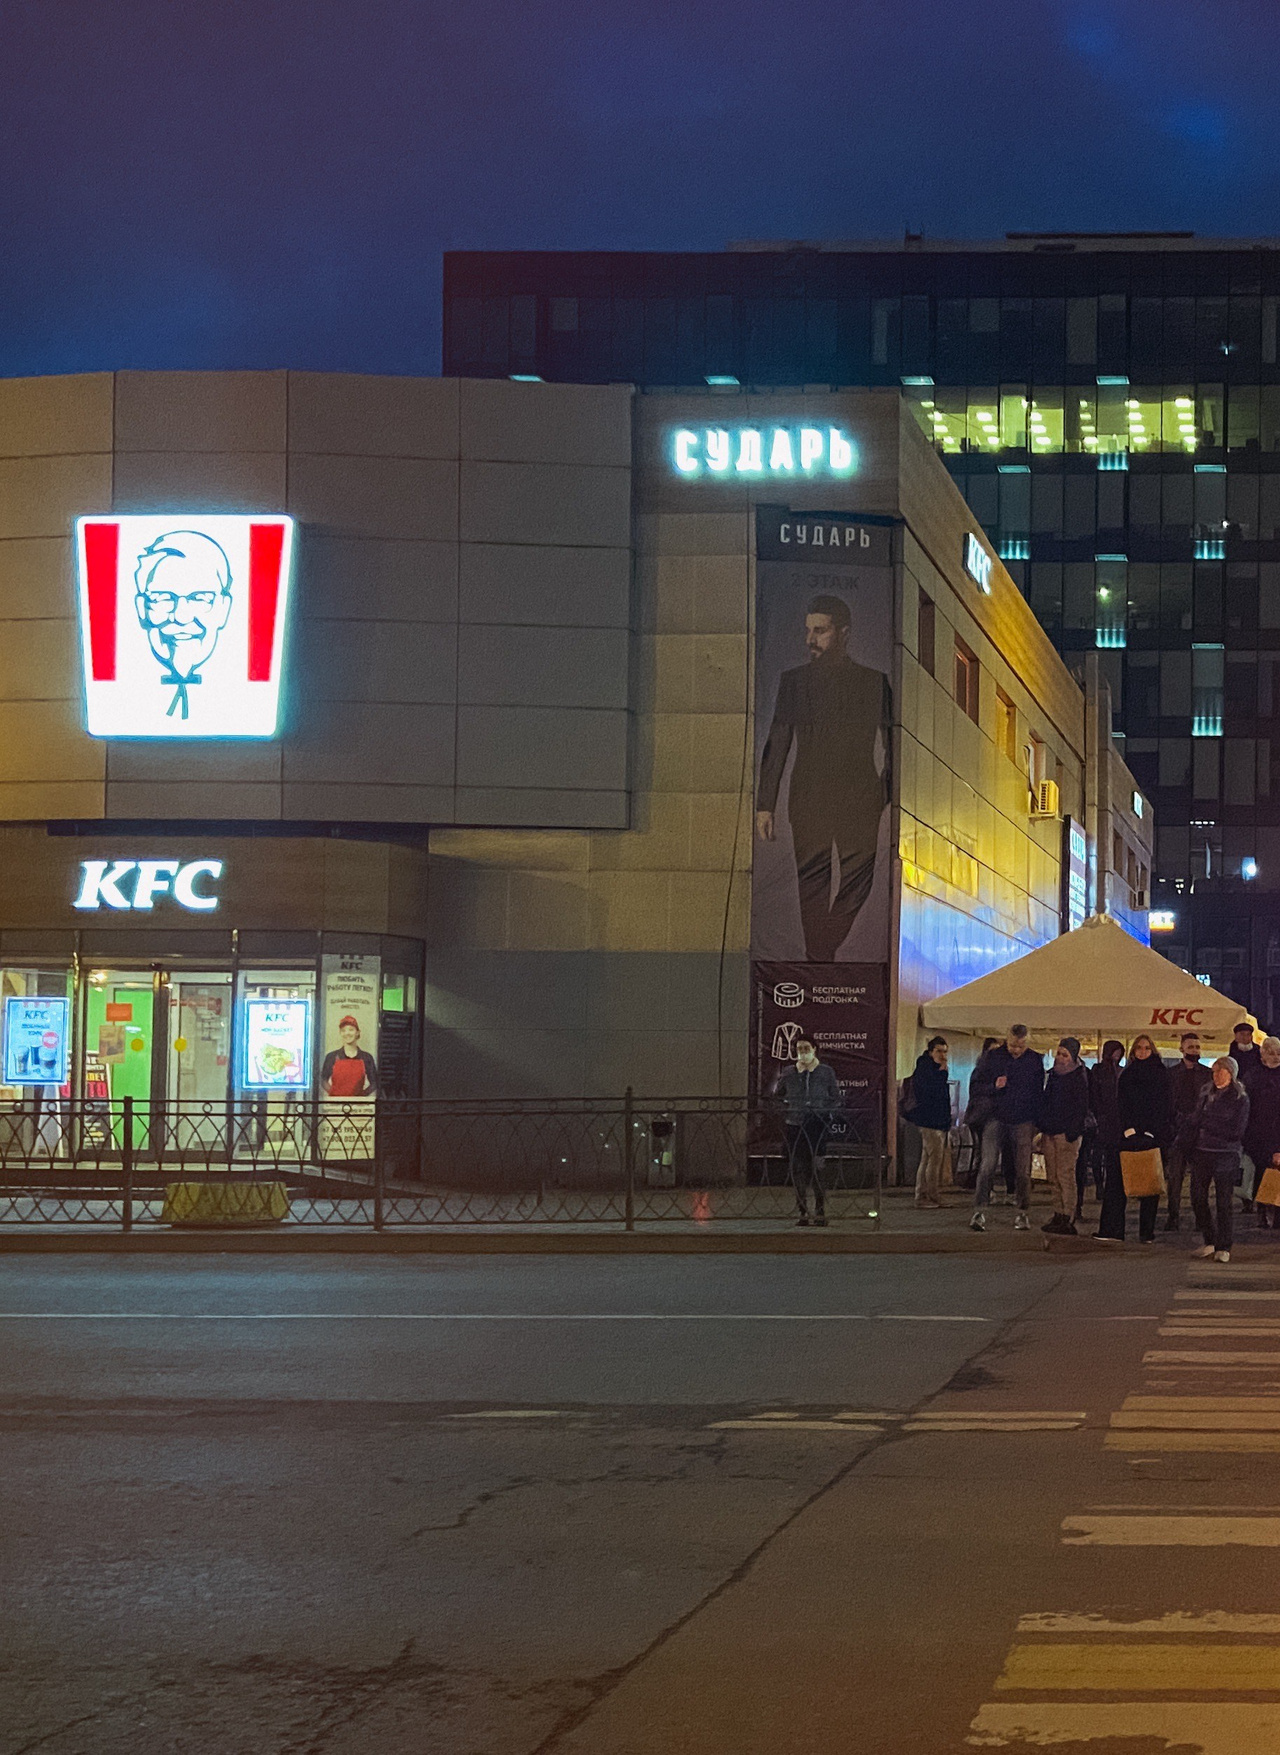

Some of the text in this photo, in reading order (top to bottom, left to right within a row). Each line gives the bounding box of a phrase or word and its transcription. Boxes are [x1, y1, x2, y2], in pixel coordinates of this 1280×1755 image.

[674, 426, 853, 472] СУДАРЬ
[779, 523, 871, 548] СУДАРЬ
[967, 532, 992, 596] KFC
[74, 859, 223, 912] KFC
[341, 961, 363, 970] KFC
[812, 986, 866, 994] БЕСПЛАТНАЯ
[812, 996, 859, 1004] ПОДГОНКА
[24, 1010, 49, 1020] KFC
[265, 1013, 290, 1022] KFC
[1149, 1009, 1204, 1026] KFC
[813, 1032, 867, 1040] БЕСПЛАТНАЯ
